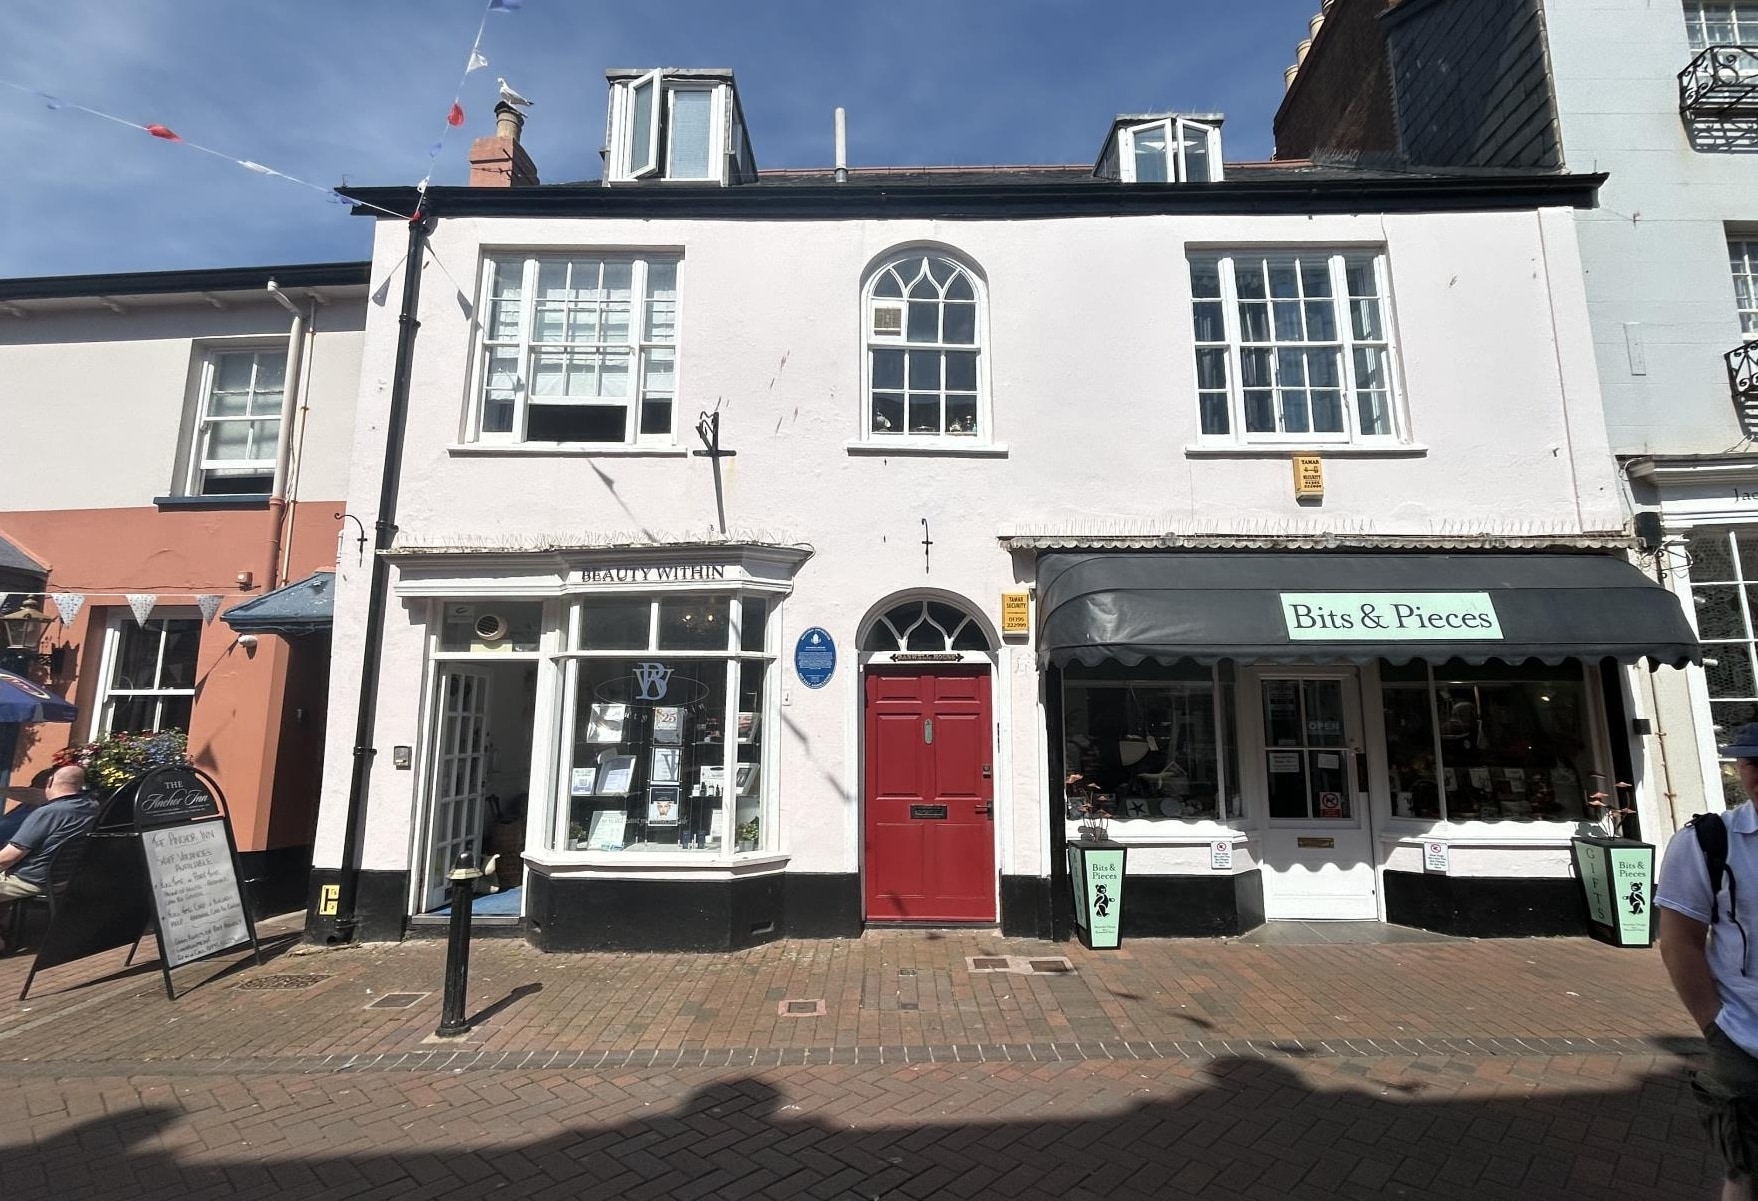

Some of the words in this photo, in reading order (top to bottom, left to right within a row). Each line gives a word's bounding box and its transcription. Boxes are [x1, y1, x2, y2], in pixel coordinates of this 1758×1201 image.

[582, 567, 652, 582] BEAUTY
[656, 565, 725, 580] WITHIN
[1290, 602, 1354, 630] Bits
[1360, 602, 1391, 630] &
[1391, 602, 1493, 630] Pieces
[1308, 721, 1340, 730] OPEN
[163, 780, 184, 790] THE
[141, 789, 185, 812] Anchor
[184, 789, 209, 807] Inn
[1092, 863, 1108, 872] Bits
[1109, 863, 1116, 872] &
[1619, 861, 1635, 870] Bits
[1637, 861, 1645, 870] &
[1092, 872, 1117, 880] Pieces
[1619, 870, 1646, 878] Pieces
[1586, 848, 1605, 919] GIFTS
